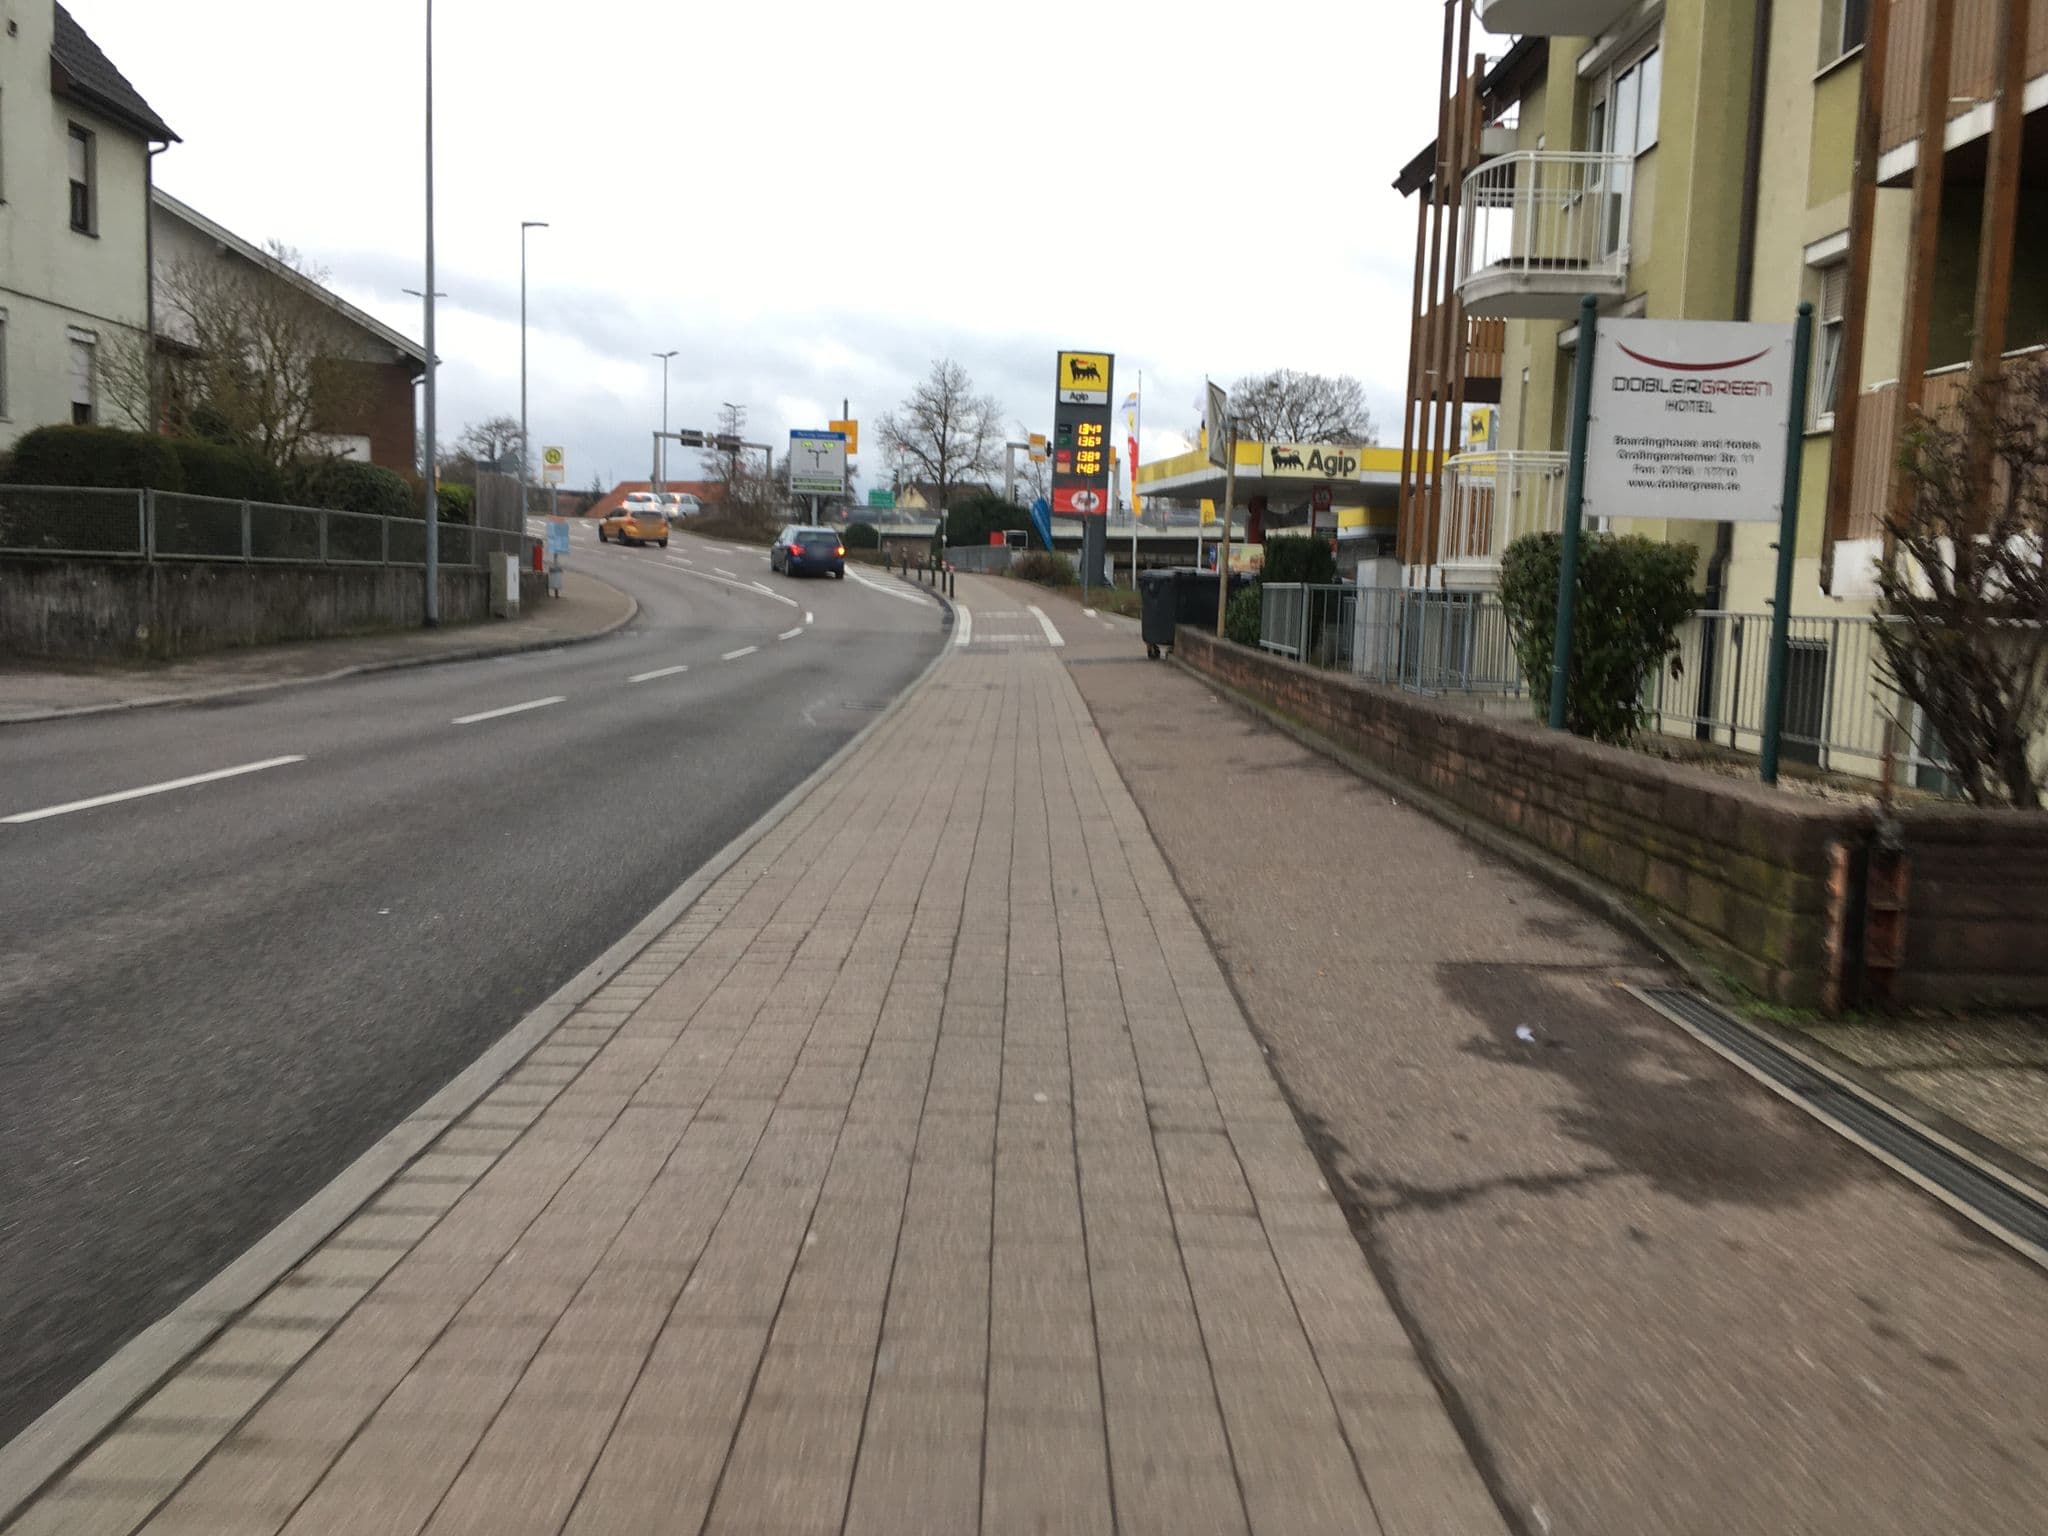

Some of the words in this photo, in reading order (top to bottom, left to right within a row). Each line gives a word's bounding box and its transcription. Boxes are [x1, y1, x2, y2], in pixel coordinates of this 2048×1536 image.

[1612, 376, 1773, 397] DOBLERGREEN
[1069, 391, 1089, 404] Agip
[1665, 400, 1716, 414] HOTEL
[1613, 435, 1697, 449] Boardinghouse
[1306, 449, 1357, 477] Agip
[1627, 479, 1741, 491] www.doblergreen.de
